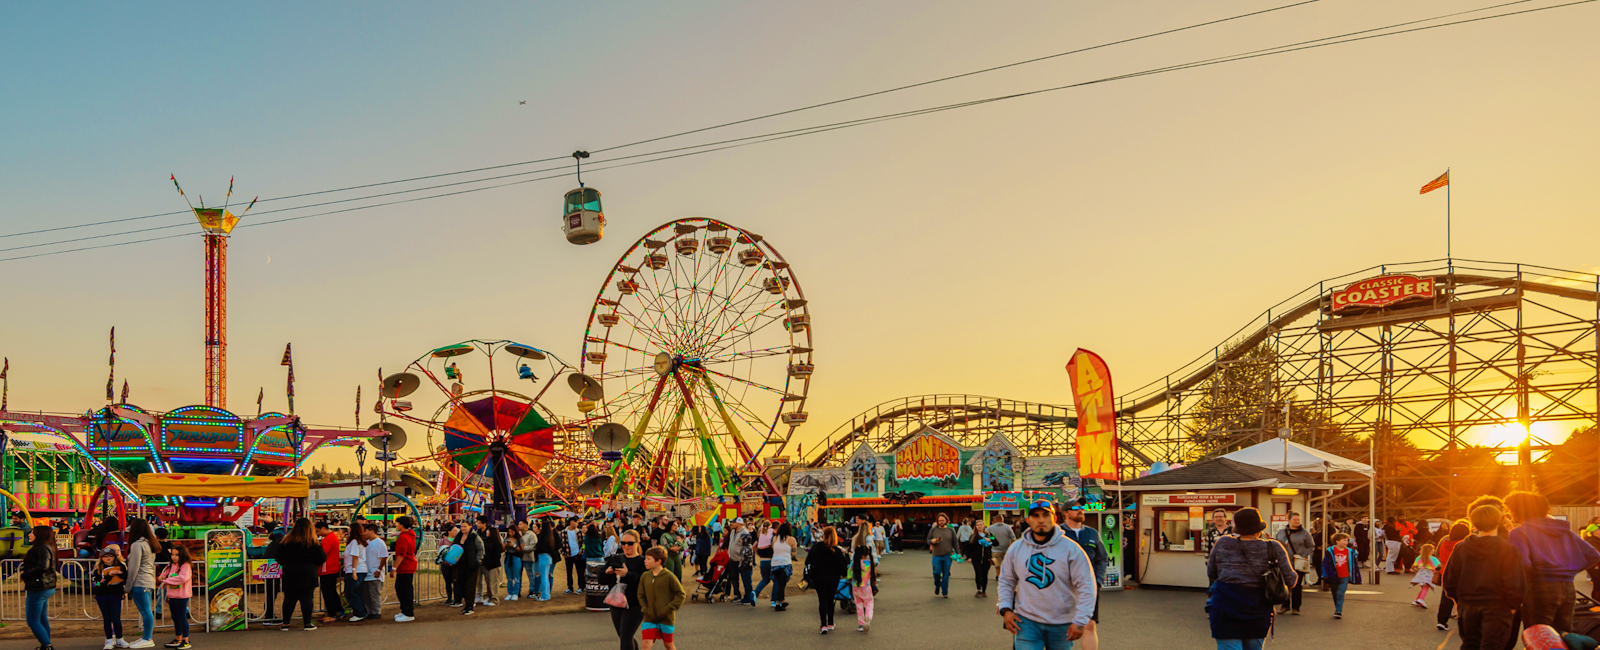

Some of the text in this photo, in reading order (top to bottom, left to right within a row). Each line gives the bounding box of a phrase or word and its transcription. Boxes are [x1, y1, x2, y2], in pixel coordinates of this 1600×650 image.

[1359, 277, 1405, 290] CLASSIC
[1335, 281, 1431, 305] COASTER
[2, 412, 82, 425] FUNTASTIC RIDES
[1076, 352, 1115, 476] ATM
[168, 429, 238, 444] TORNADO
[896, 434, 960, 463] HAUNTED
[896, 460, 960, 478] MANSION
[1107, 530, 1115, 566] ATM
[258, 562, 280, 574] 12
